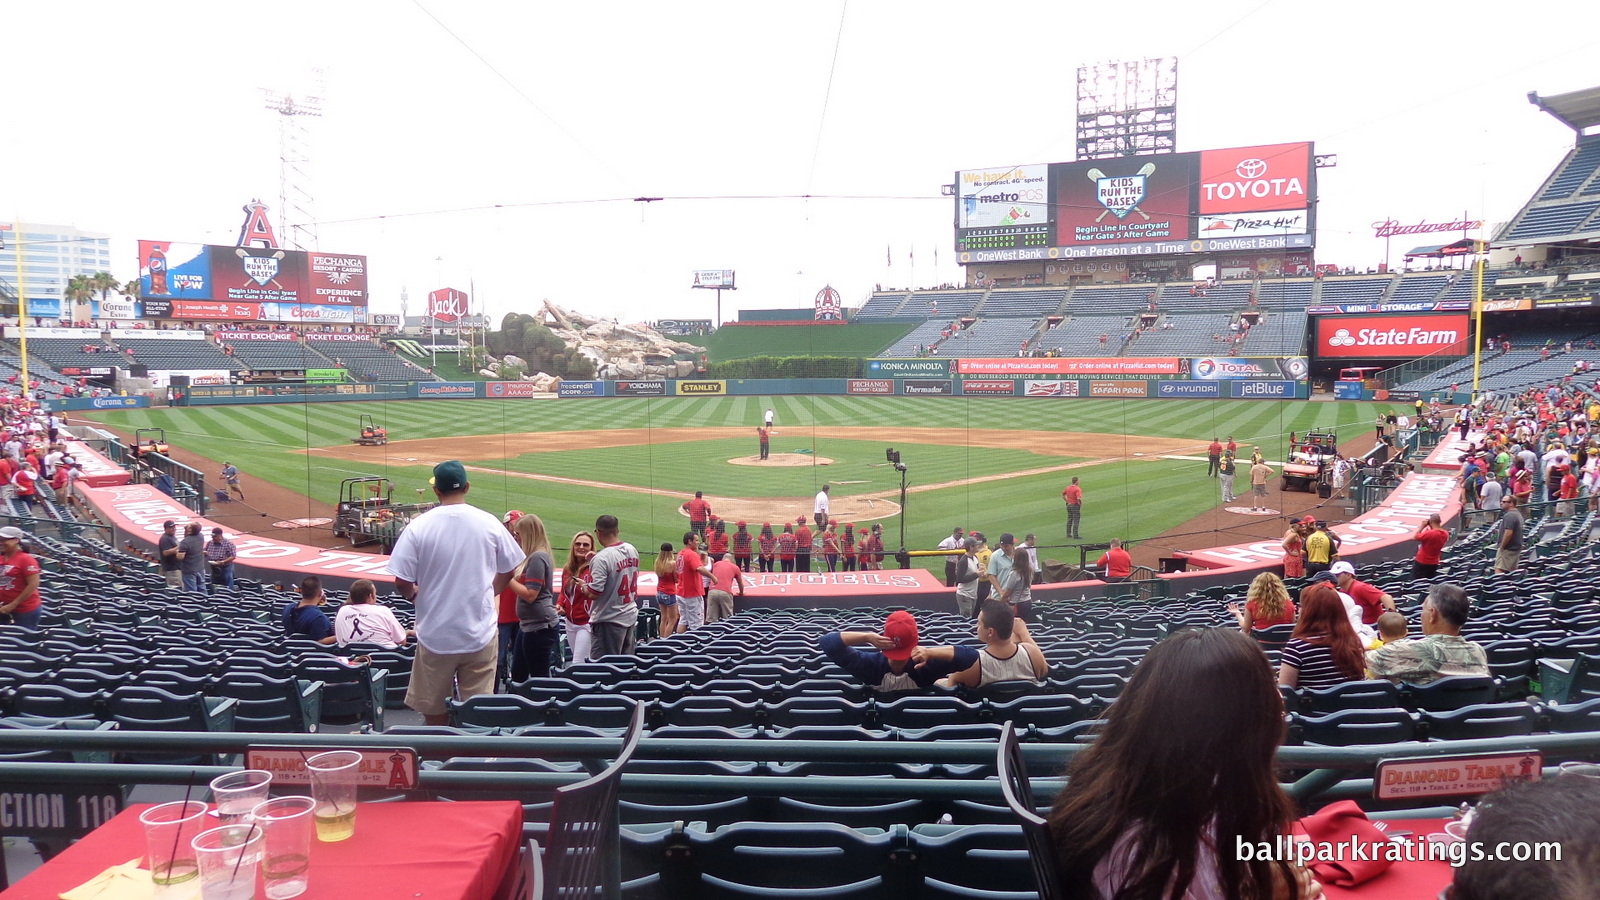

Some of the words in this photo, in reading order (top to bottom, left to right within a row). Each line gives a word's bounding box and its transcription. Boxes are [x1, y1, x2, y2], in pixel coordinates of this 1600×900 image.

[963, 173, 981, 183] We
[984, 172, 1012, 182] have
[1014, 170, 1026, 179] it.
[1110, 178, 1133, 187] KIDS
[1100, 188, 1121, 197] RUN
[1124, 186, 1142, 195] THE
[1203, 178, 1304, 200] TOYOTA
[980, 188, 1044, 204] metroPCS
[1106, 197, 1136, 207] BASES
[1076, 226, 1098, 234] Begin
[1100, 224, 1116, 232] Line
[1128, 221, 1169, 232] Courtyard
[1233, 218, 1271, 232] Pizza
[1274, 215, 1302, 228] Hut
[1371, 218, 1483, 238] Budweiser
[1076, 233, 1094, 241] Near
[1096, 232, 1115, 240] Gate
[1122, 230, 1144, 238] After
[1146, 229, 1169, 237] Game
[1065, 248, 1086, 258] One
[1090, 246, 1127, 256] Person
[1131, 245, 1140, 253] at
[1156, 242, 1184, 253] Time
[1209, 240, 1256, 250] OneWest
[1259, 238, 1286, 247] Bank
[977, 251, 1016, 261] OneWest
[1019, 249, 1041, 259] Bank
[313, 256, 363, 267] PECHANGA
[316, 288, 362, 296] EXPERIENCE
[431, 292, 467, 317] Jack
[234, 308, 250, 316] hoag
[291, 307, 320, 317] Coors
[1220, 363, 1263, 372] TOTAL
[1241, 383, 1284, 396] jetBlue
[94, 398, 121, 408] Corona
[618, 570, 638, 604] 44
[1384, 768, 1460, 786] DIAMOND
[77, 795, 116, 828] 118
